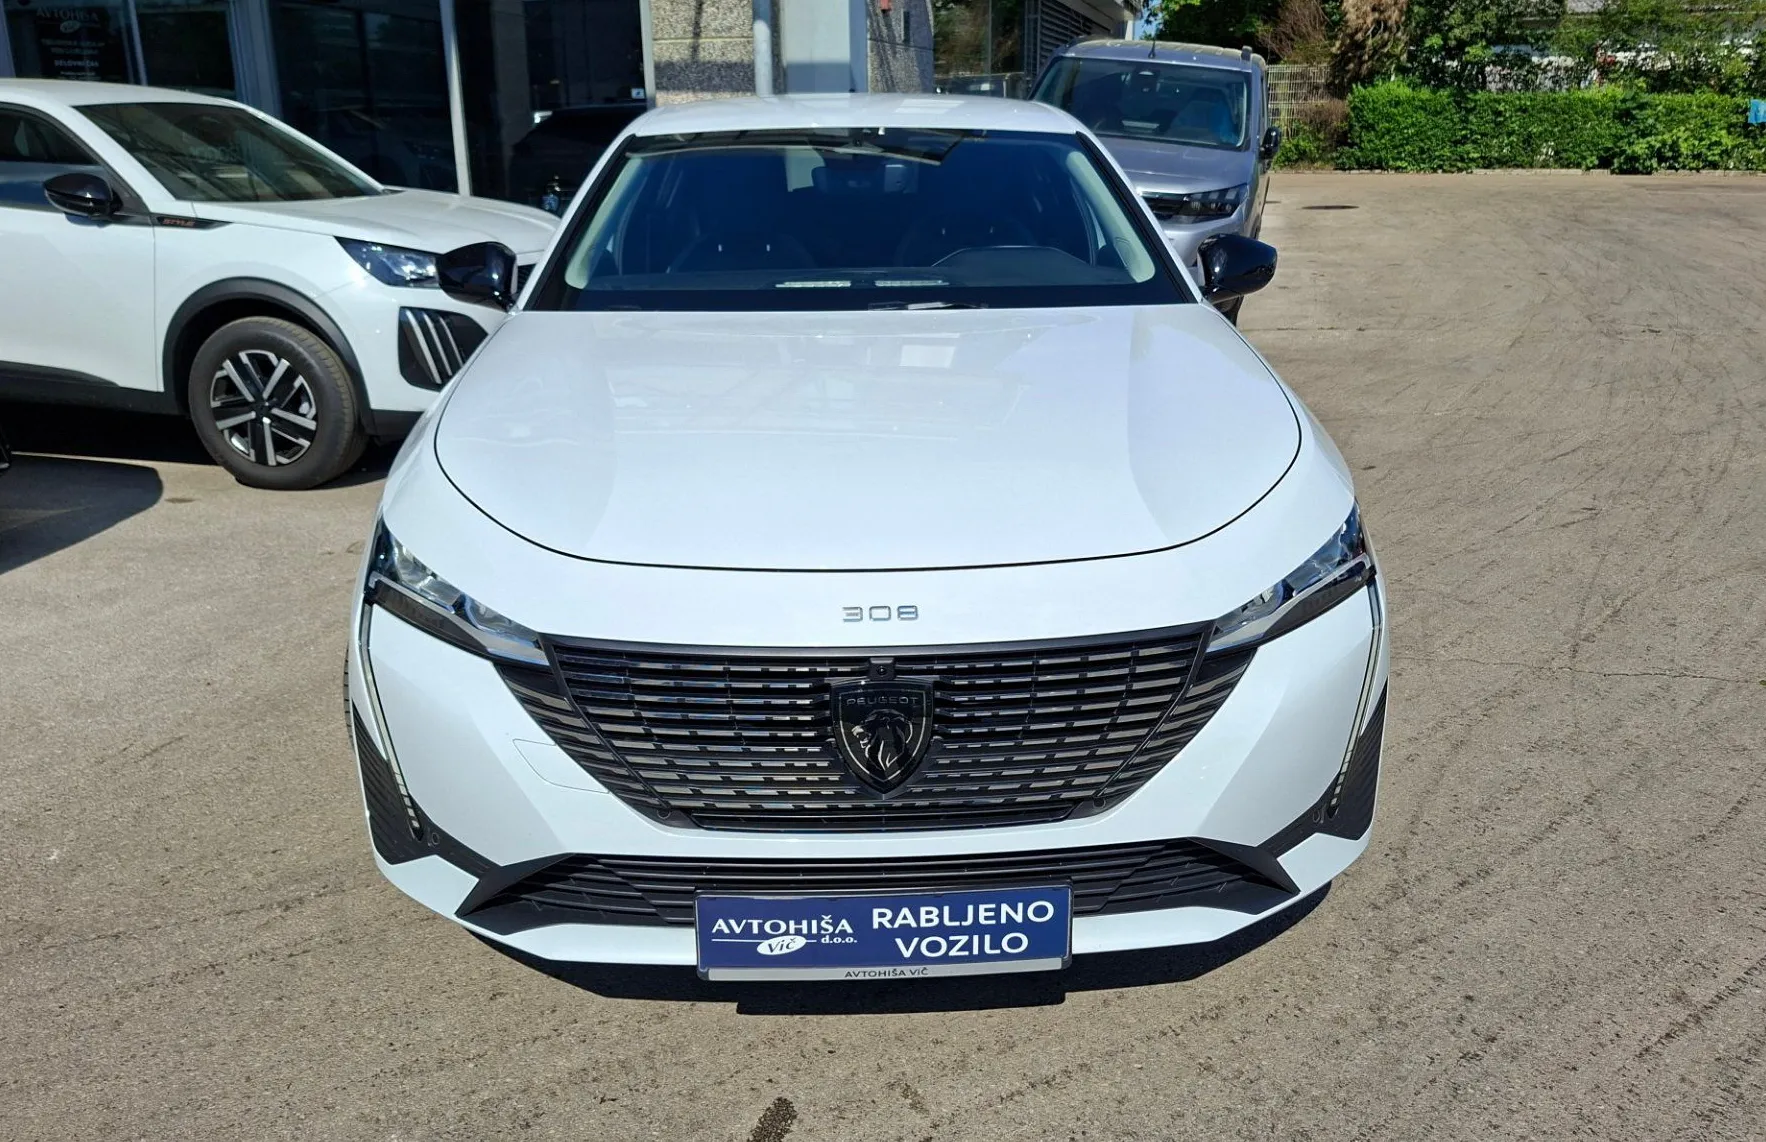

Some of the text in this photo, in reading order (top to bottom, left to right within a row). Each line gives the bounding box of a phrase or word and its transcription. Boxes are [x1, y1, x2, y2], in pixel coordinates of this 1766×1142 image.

[842, 605, 918, 622] 308
[846, 696, 919, 705] PEUGEOT
[872, 900, 1055, 929] RABLJENO
[711, 914, 853, 935] AVTOHIŠA
[767, 934, 857, 953] Vič d.o.o.
[895, 932, 1029, 958] VOZILO
[844, 968, 907, 978] AVTOHIŠA
